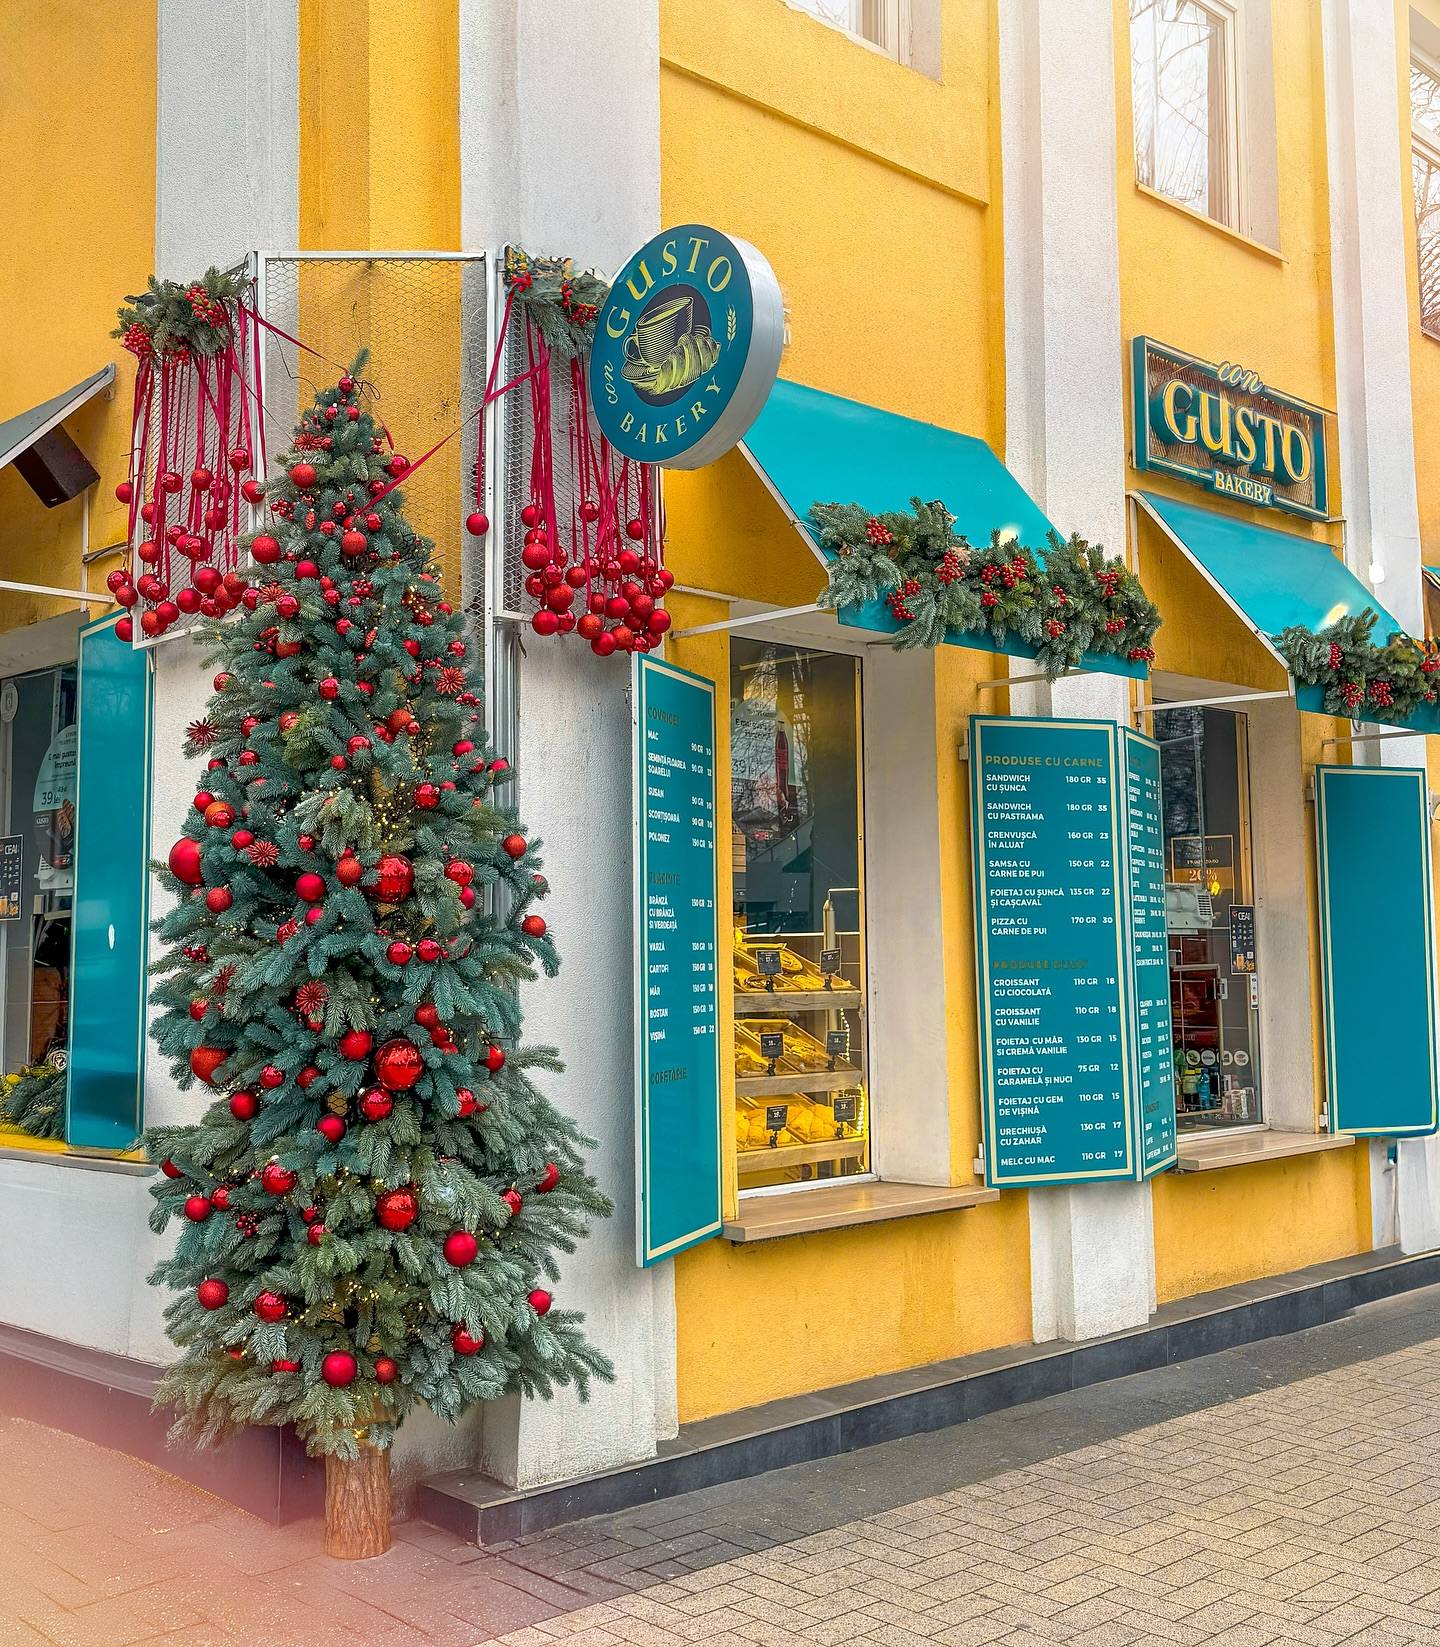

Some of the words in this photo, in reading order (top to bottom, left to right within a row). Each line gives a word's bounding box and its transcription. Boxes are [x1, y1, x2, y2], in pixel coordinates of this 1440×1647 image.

[606, 237, 732, 339] GUSTO
[602, 360, 619, 404] con
[1217, 361, 1263, 394] con
[619, 376, 721, 443] BAKERY
[1163, 379, 1311, 483] GUSTO
[1214, 470, 1272, 504] BAKERY
[648, 730, 658, 740] MAC
[985, 756, 1042, 766] PRODUSE
[1045, 756, 1060, 766] CU
[1064, 757, 1103, 767] CARNE
[41, 792, 53, 805] 39
[648, 787, 664, 797] SUSAN
[650, 965, 668, 973] CARTOFI
[650, 1009, 668, 1018] BOSTAN
[1013, 1137, 1041, 1145] ZAHAR
